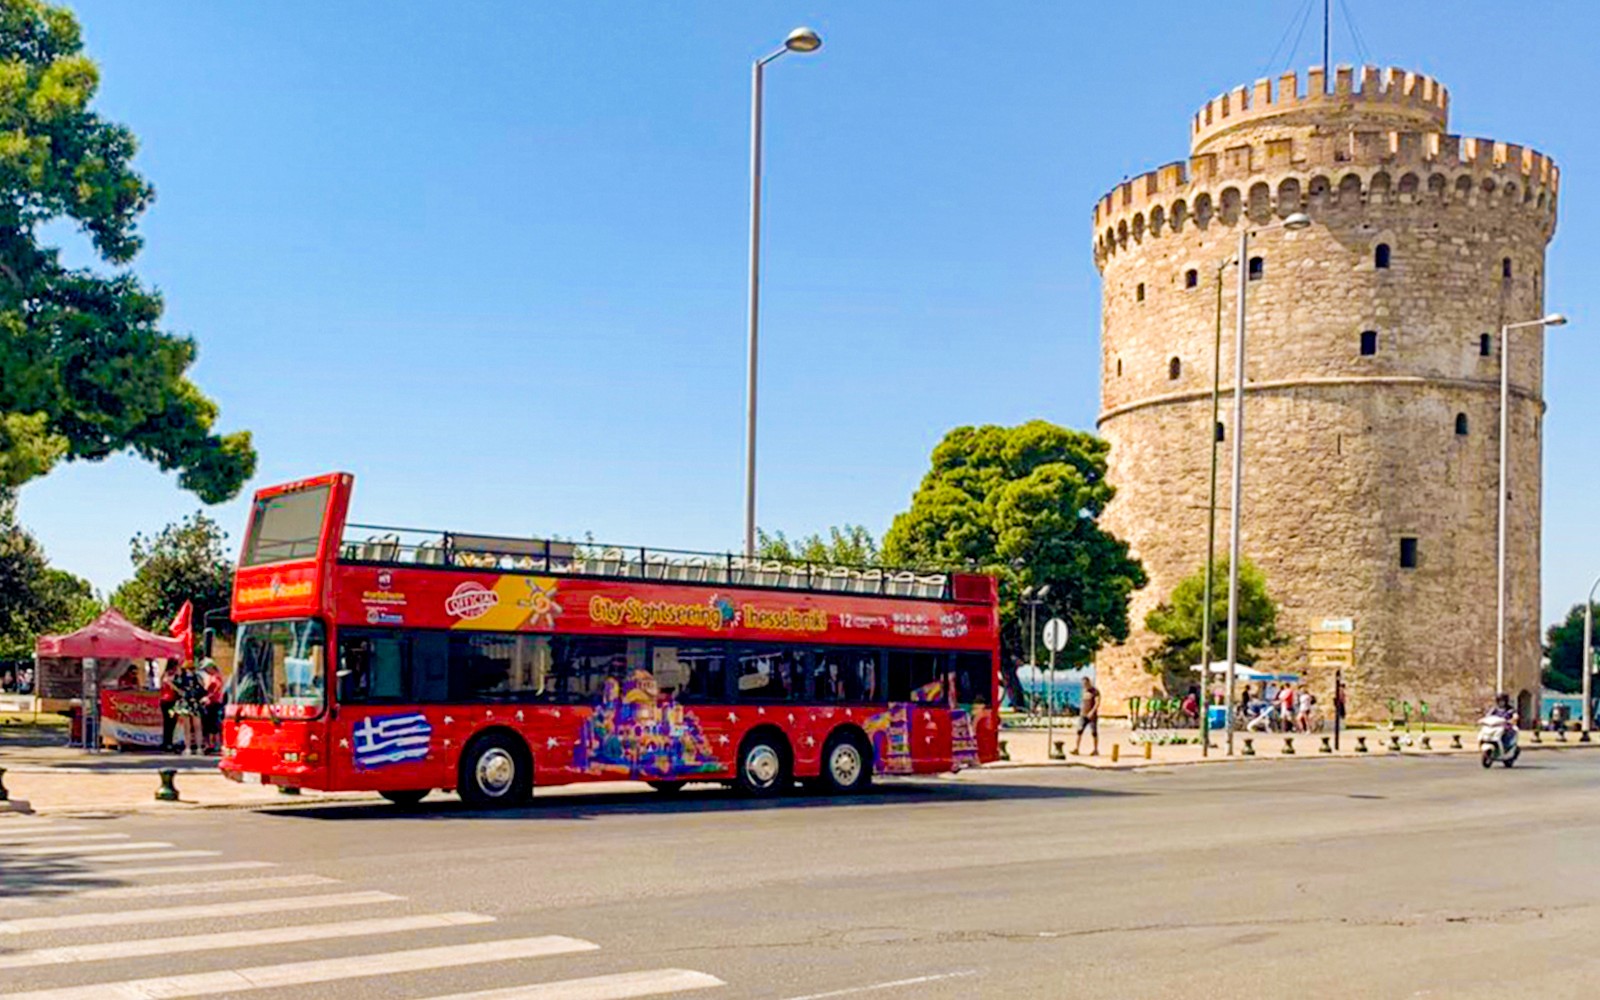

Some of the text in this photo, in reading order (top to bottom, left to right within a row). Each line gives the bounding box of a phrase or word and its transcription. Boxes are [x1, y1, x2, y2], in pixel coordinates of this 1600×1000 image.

[589, 595, 722, 631] City Sightseeing
[742, 603, 827, 631] Thessaloniki
[839, 613, 852, 628] 12
